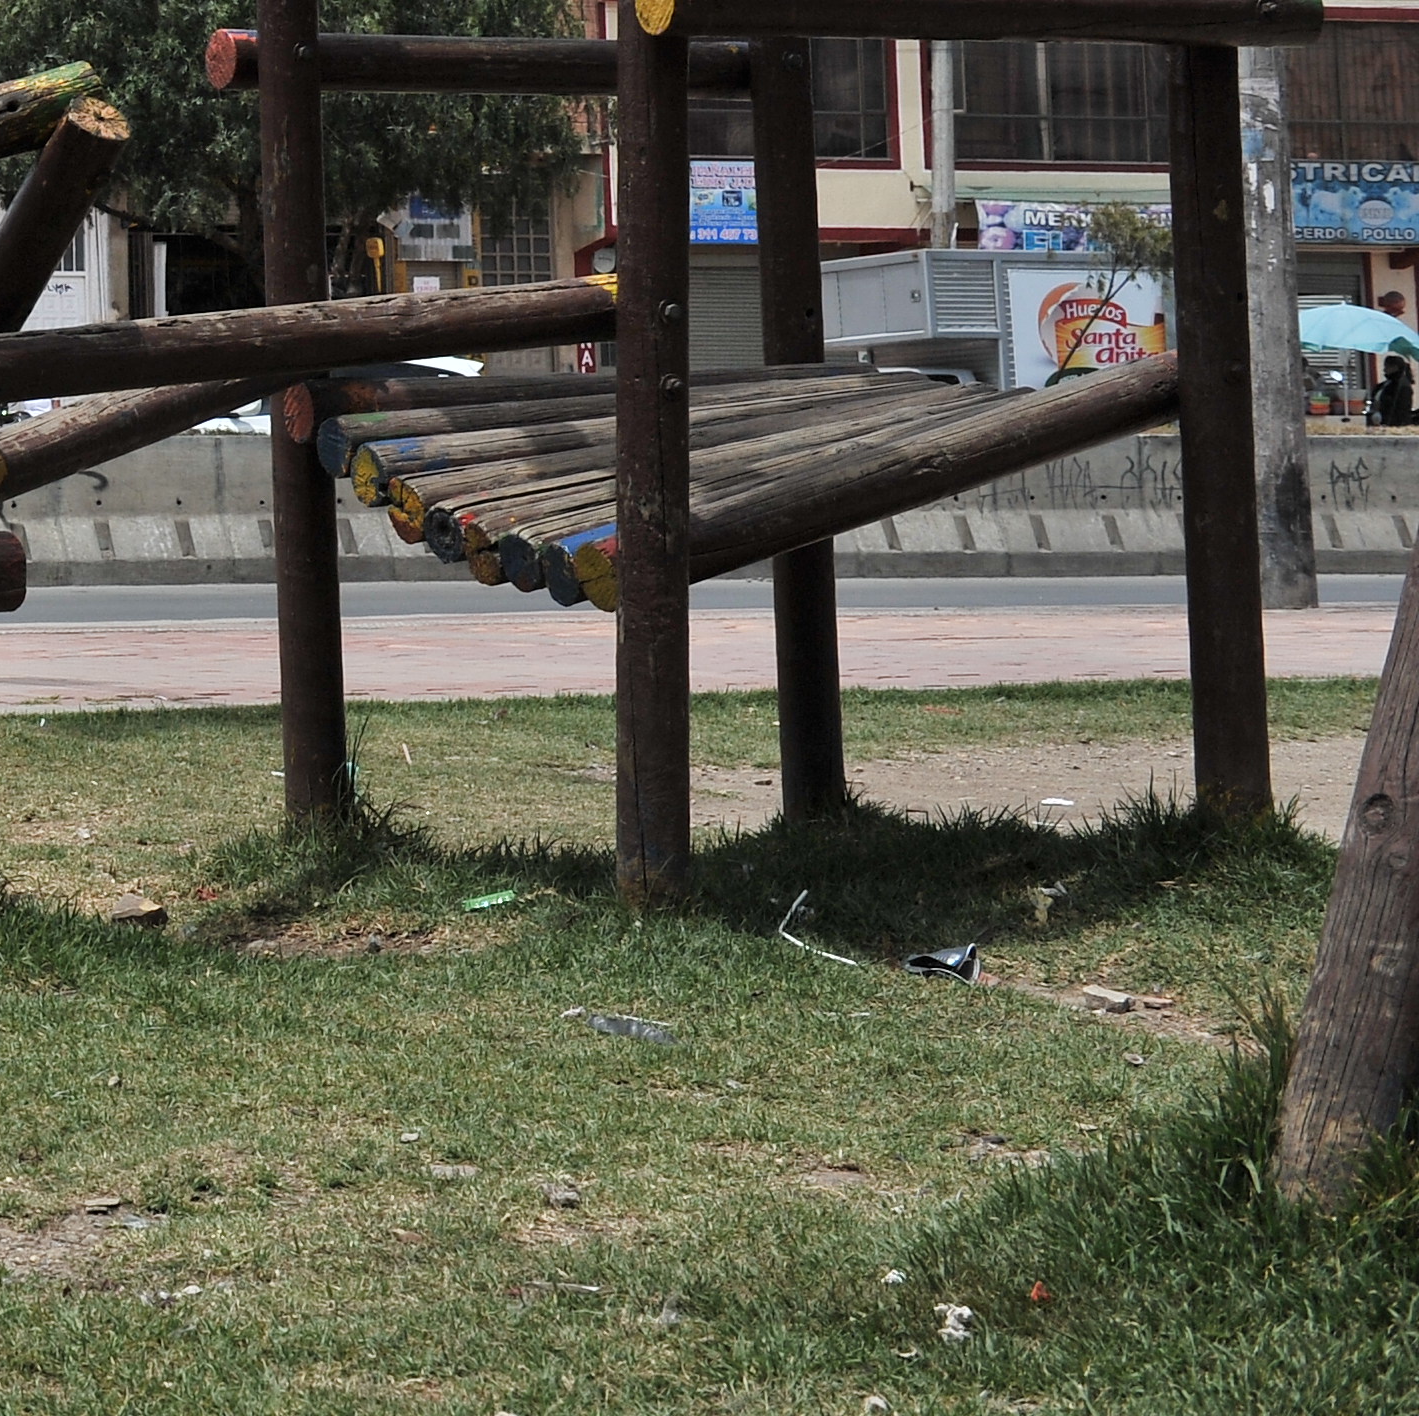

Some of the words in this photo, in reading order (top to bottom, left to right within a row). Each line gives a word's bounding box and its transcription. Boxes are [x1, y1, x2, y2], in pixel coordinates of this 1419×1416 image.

[1294, 228, 1348, 240] CERDO
[1363, 229, 1415, 240] POLLO
[1065, 302, 1123, 321] Huevos
[1065, 327, 1137, 351] Santa
